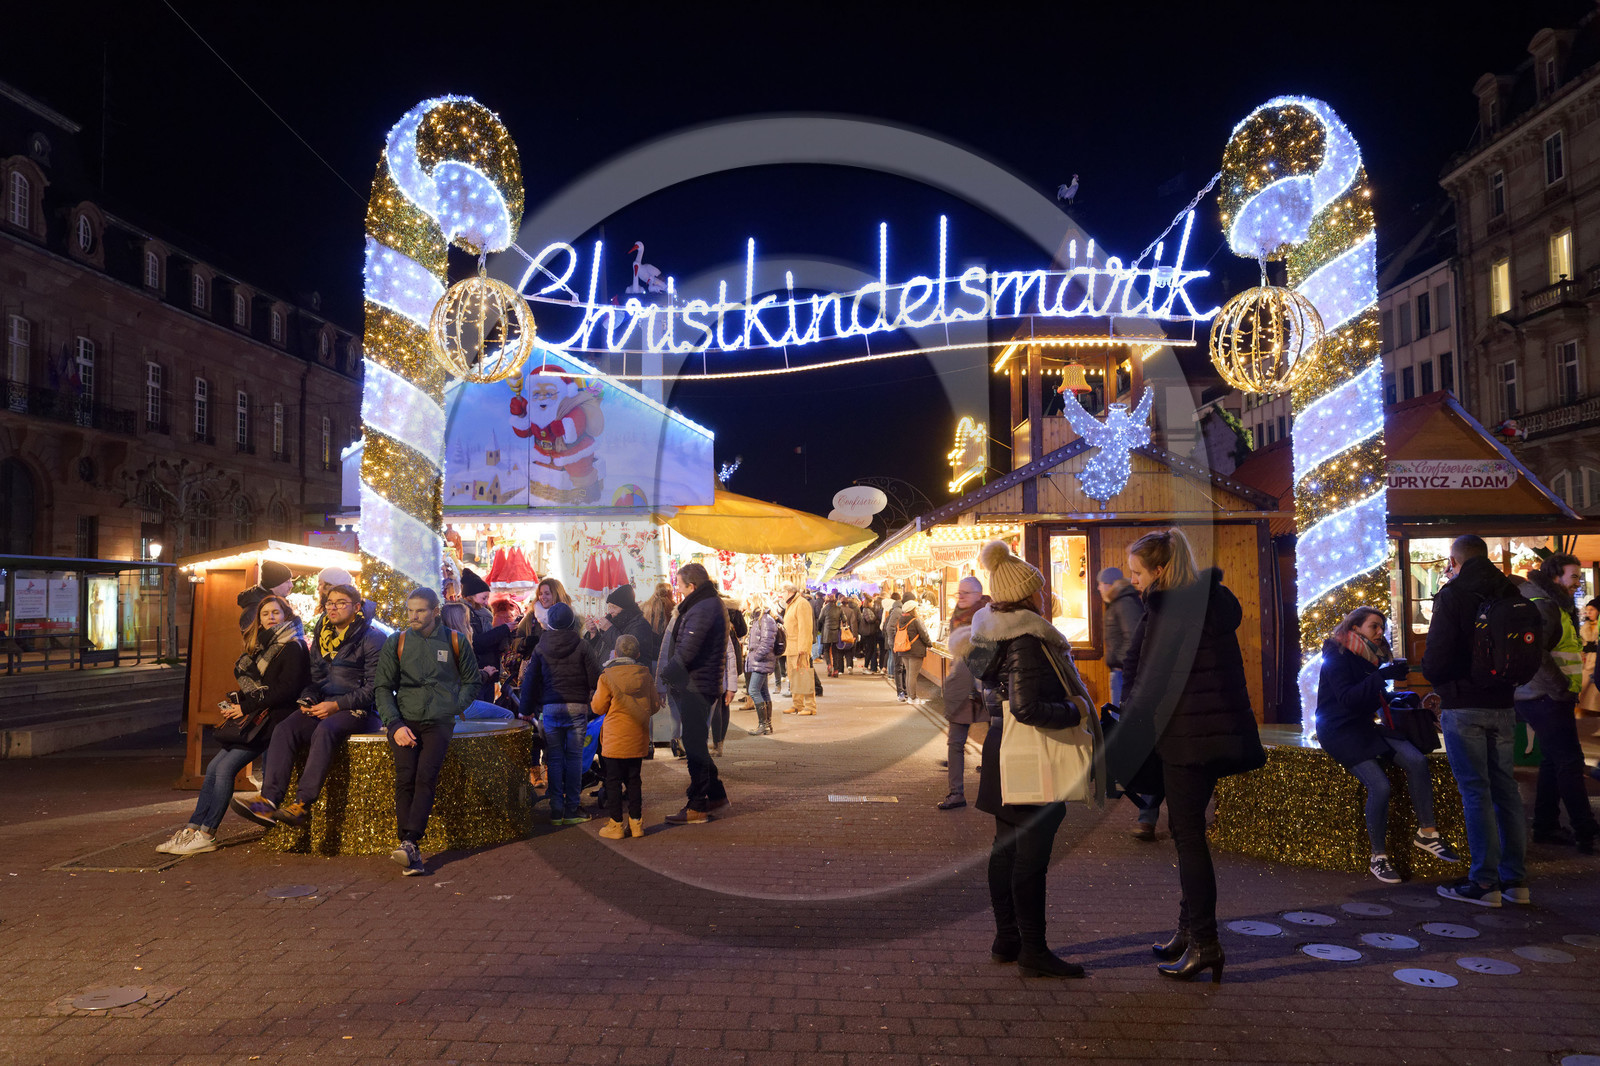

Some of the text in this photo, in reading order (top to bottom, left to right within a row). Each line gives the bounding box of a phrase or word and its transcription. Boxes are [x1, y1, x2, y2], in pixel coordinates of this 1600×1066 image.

[516, 210, 1221, 353] Christkindelsmärik
[1411, 461, 1473, 477] Confiserie
[1385, 476, 1450, 488] UPRYCZ
[1461, 476, 1508, 488] ADAM
